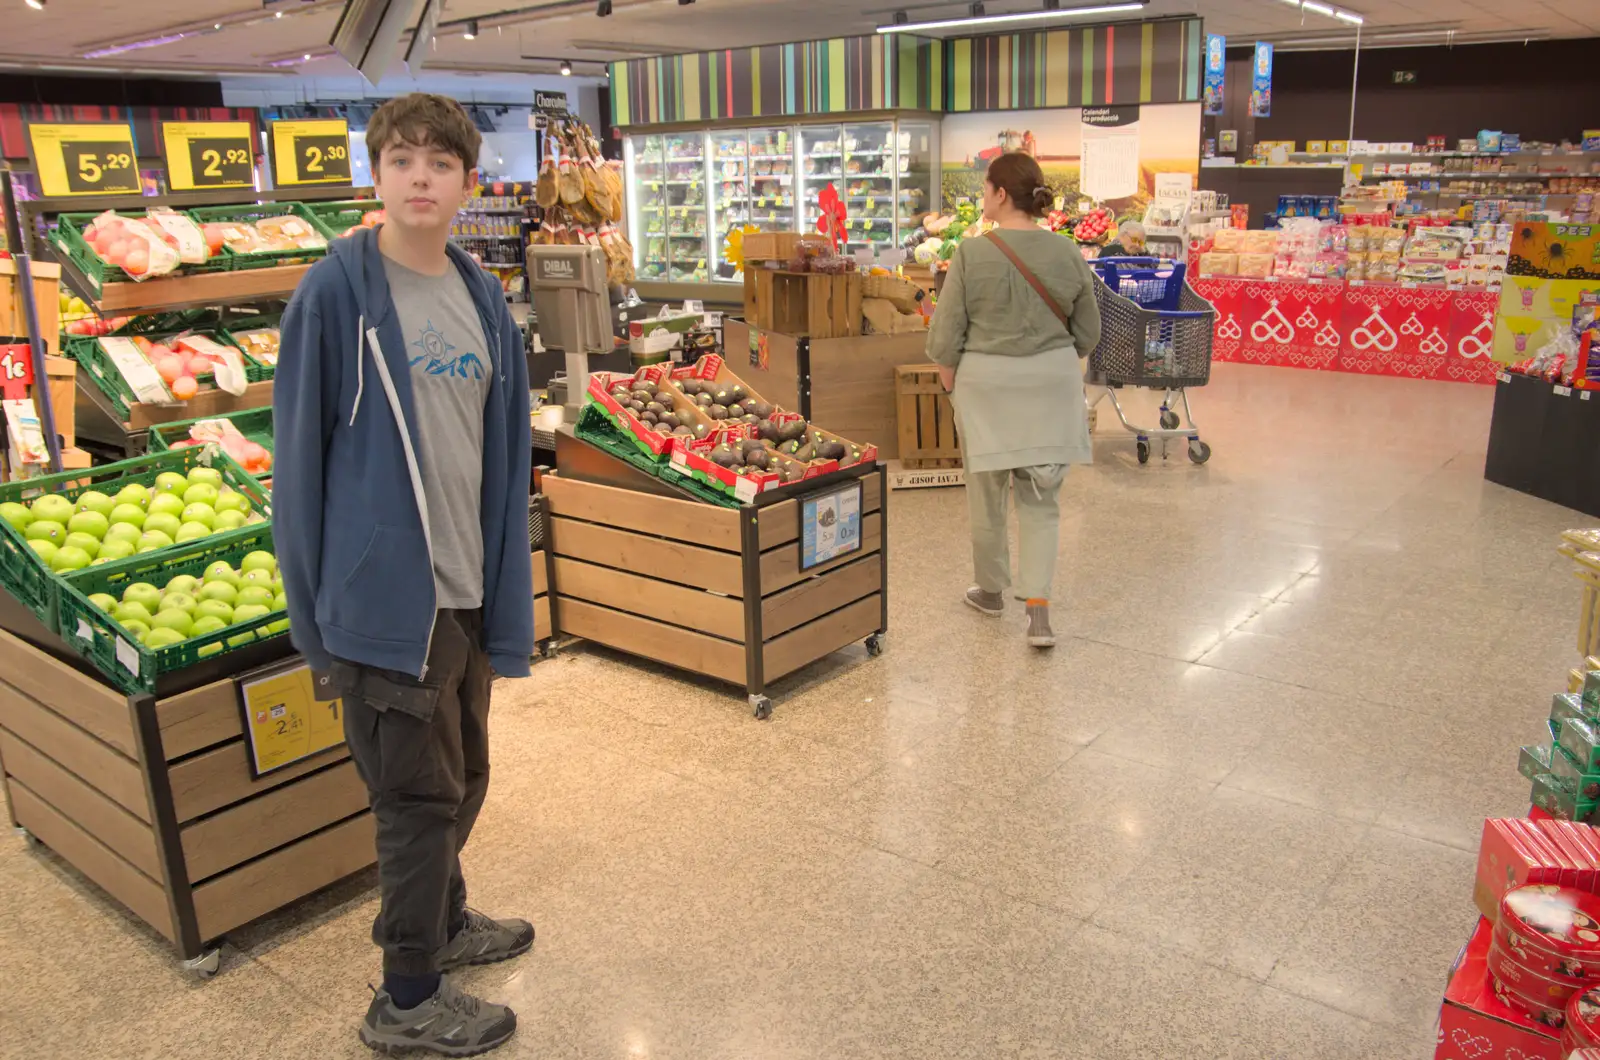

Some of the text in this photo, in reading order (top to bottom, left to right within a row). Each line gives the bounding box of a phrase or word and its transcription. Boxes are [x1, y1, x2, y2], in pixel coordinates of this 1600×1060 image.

[1090, 114, 1119, 123] producció
[78, 153, 131, 183] 5,29
[201, 149, 249, 177] 2,92
[305, 145, 346, 172] 2,30
[1555, 225, 1592, 237] PEZ
[543, 259, 574, 273] DIBAL
[0, 350, 26, 380] 1€
[909, 476, 935, 485] JOSEP
